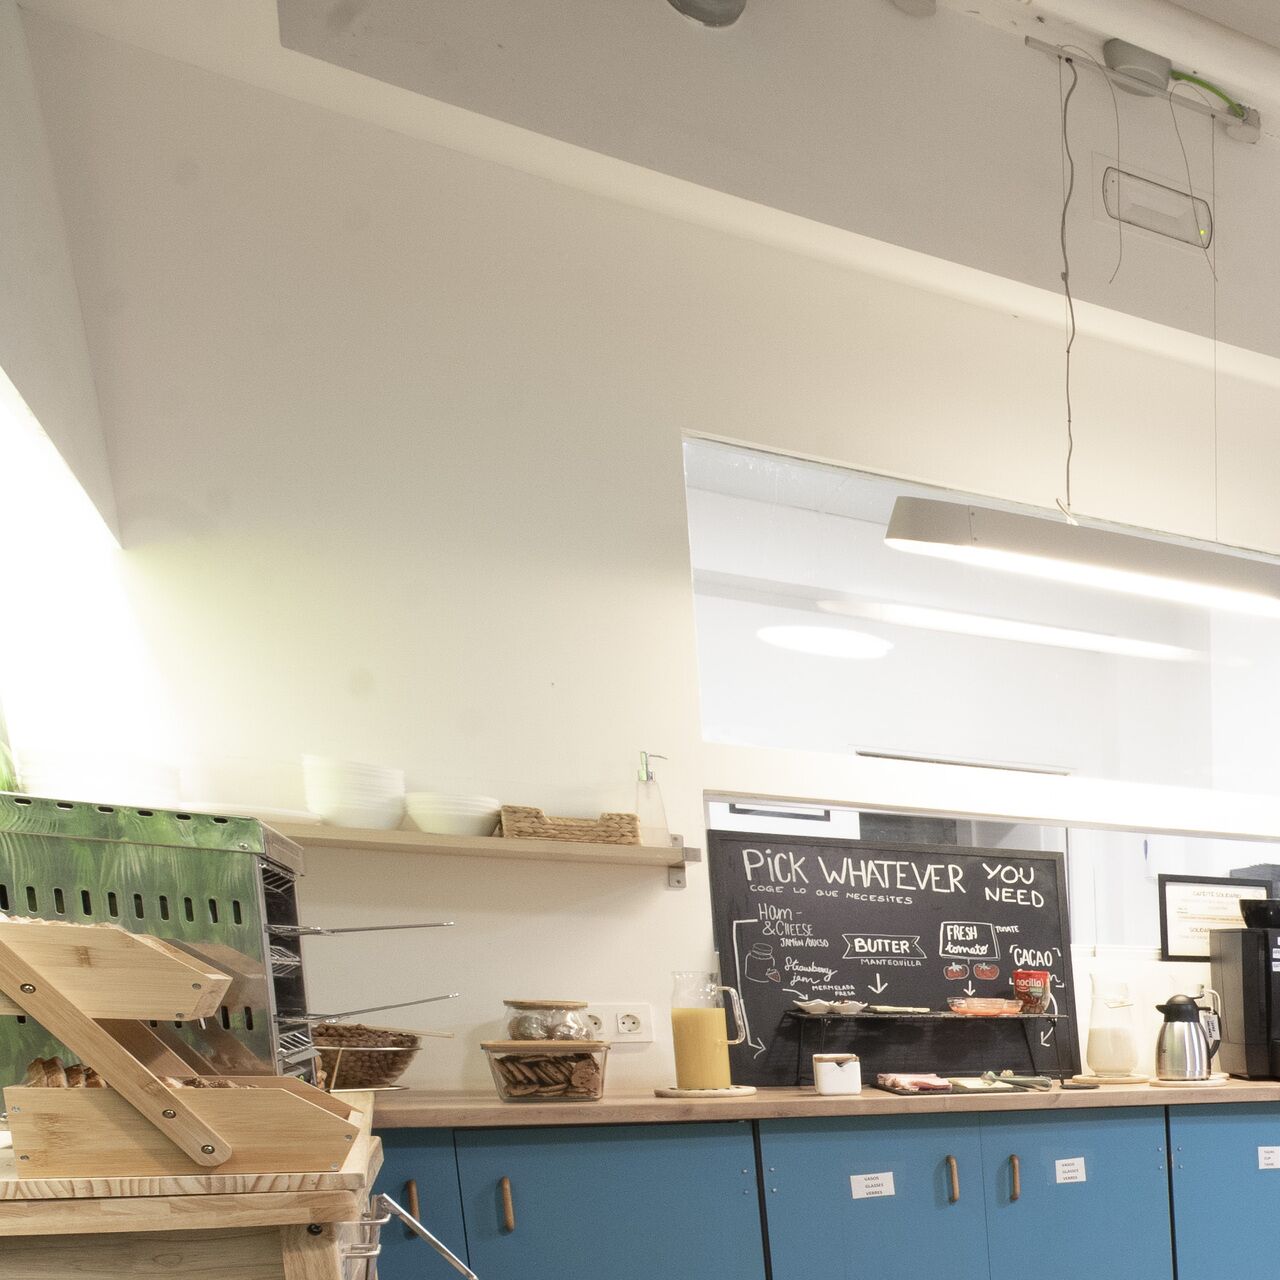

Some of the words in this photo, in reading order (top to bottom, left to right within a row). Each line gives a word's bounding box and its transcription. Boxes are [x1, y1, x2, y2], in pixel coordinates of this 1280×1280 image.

[818, 856, 966, 893] WHATEVER
[982, 862, 1035, 884] YOU
[749, 884, 784, 893] COGE
[816, 889, 839, 898] QUE
[985, 887, 1044, 908] NEED
[946, 925, 978, 940] FRESH
[854, 937, 910, 954] BUTTER
[945, 942, 989, 955] tomato
[1013, 948, 1053, 967] CACAO
[784, 956, 838, 982] Strawberry
[790, 972, 820, 986] jam
